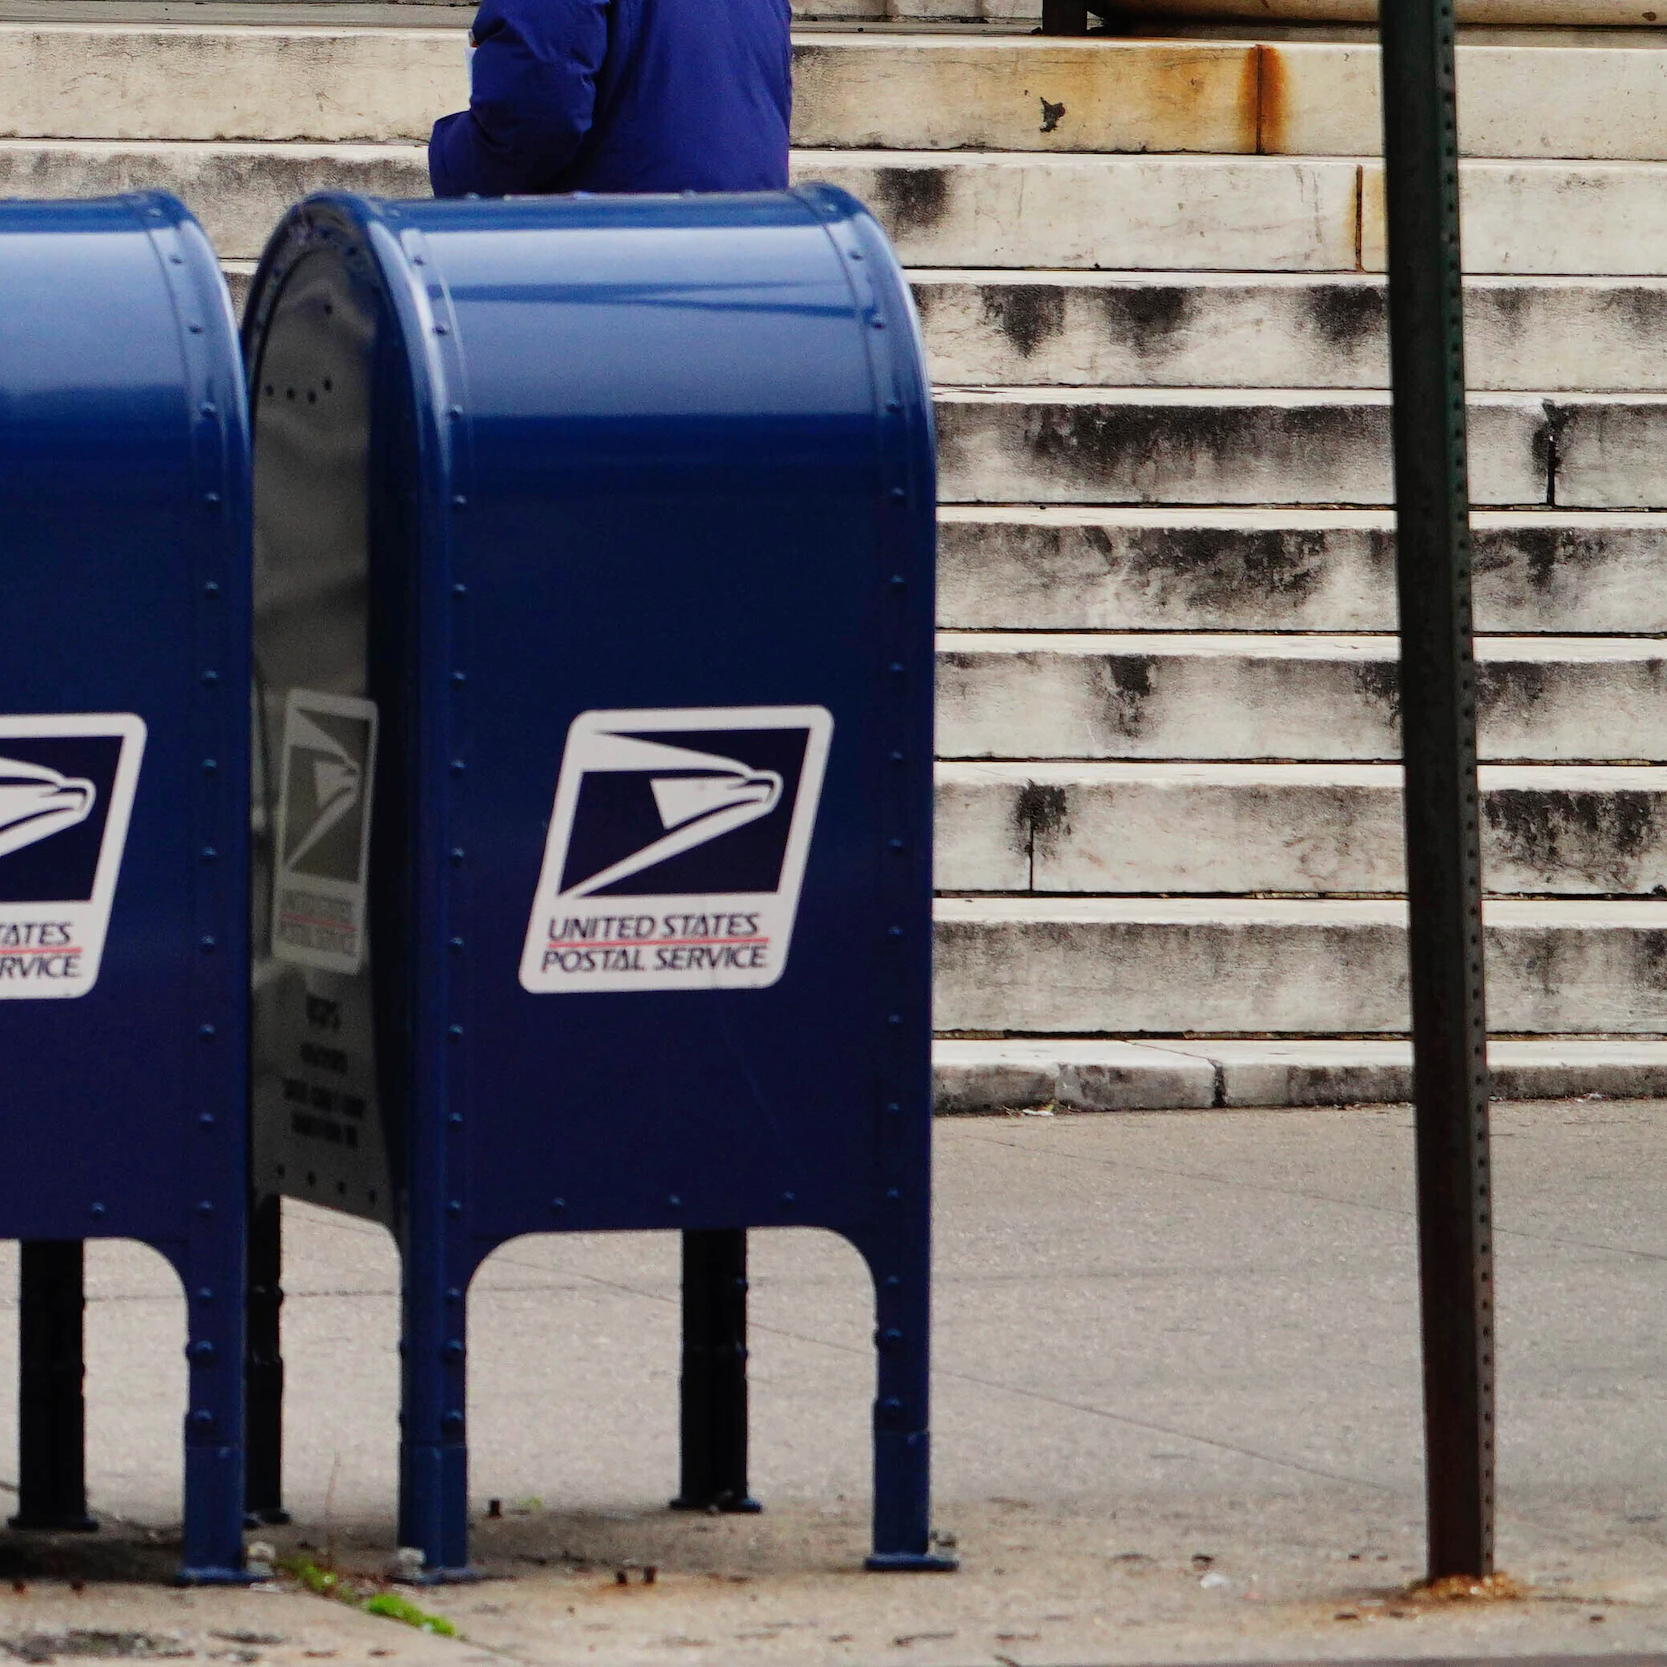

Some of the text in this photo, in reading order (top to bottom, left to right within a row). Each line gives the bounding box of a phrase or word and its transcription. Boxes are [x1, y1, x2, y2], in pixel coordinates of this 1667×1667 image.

[548, 913, 759, 941] UNITED STATES
[542, 946, 768, 973] POSTAL SERVICE
